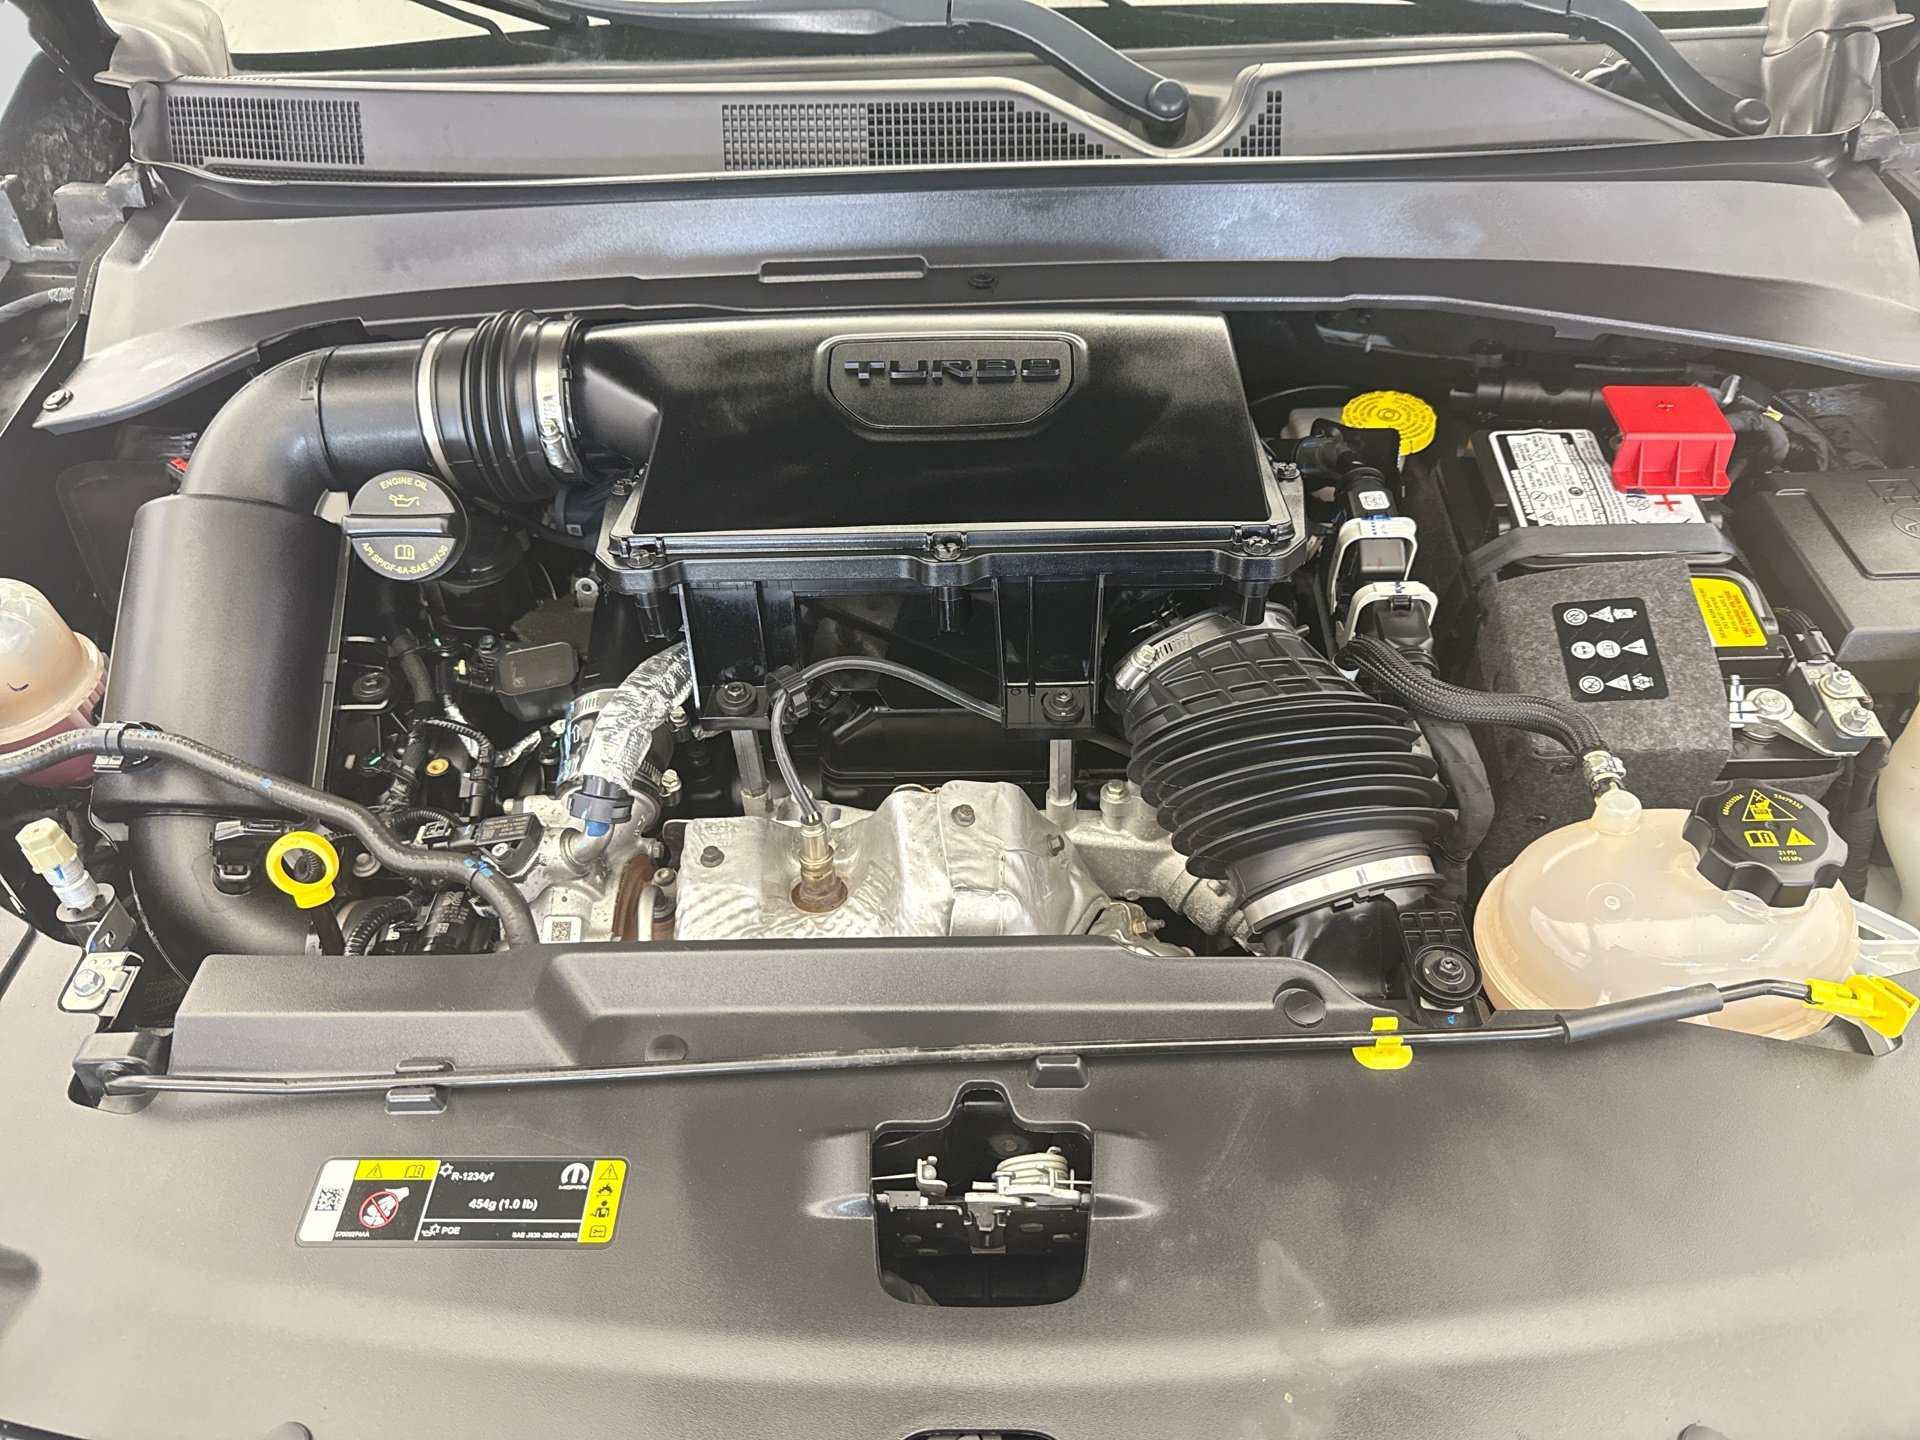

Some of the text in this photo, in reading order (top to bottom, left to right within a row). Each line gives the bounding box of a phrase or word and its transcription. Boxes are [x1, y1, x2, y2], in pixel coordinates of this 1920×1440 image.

[379, 476, 428, 491] ENGINE OIL
[361, 542, 375, 557] API
[429, 544, 449, 567] 5W-30
[450, 1171, 496, 1184] R-1234yf
[468, 1198, 539, 1212] 454g (1.0 lb)
[440, 1226, 462, 1236] POE
